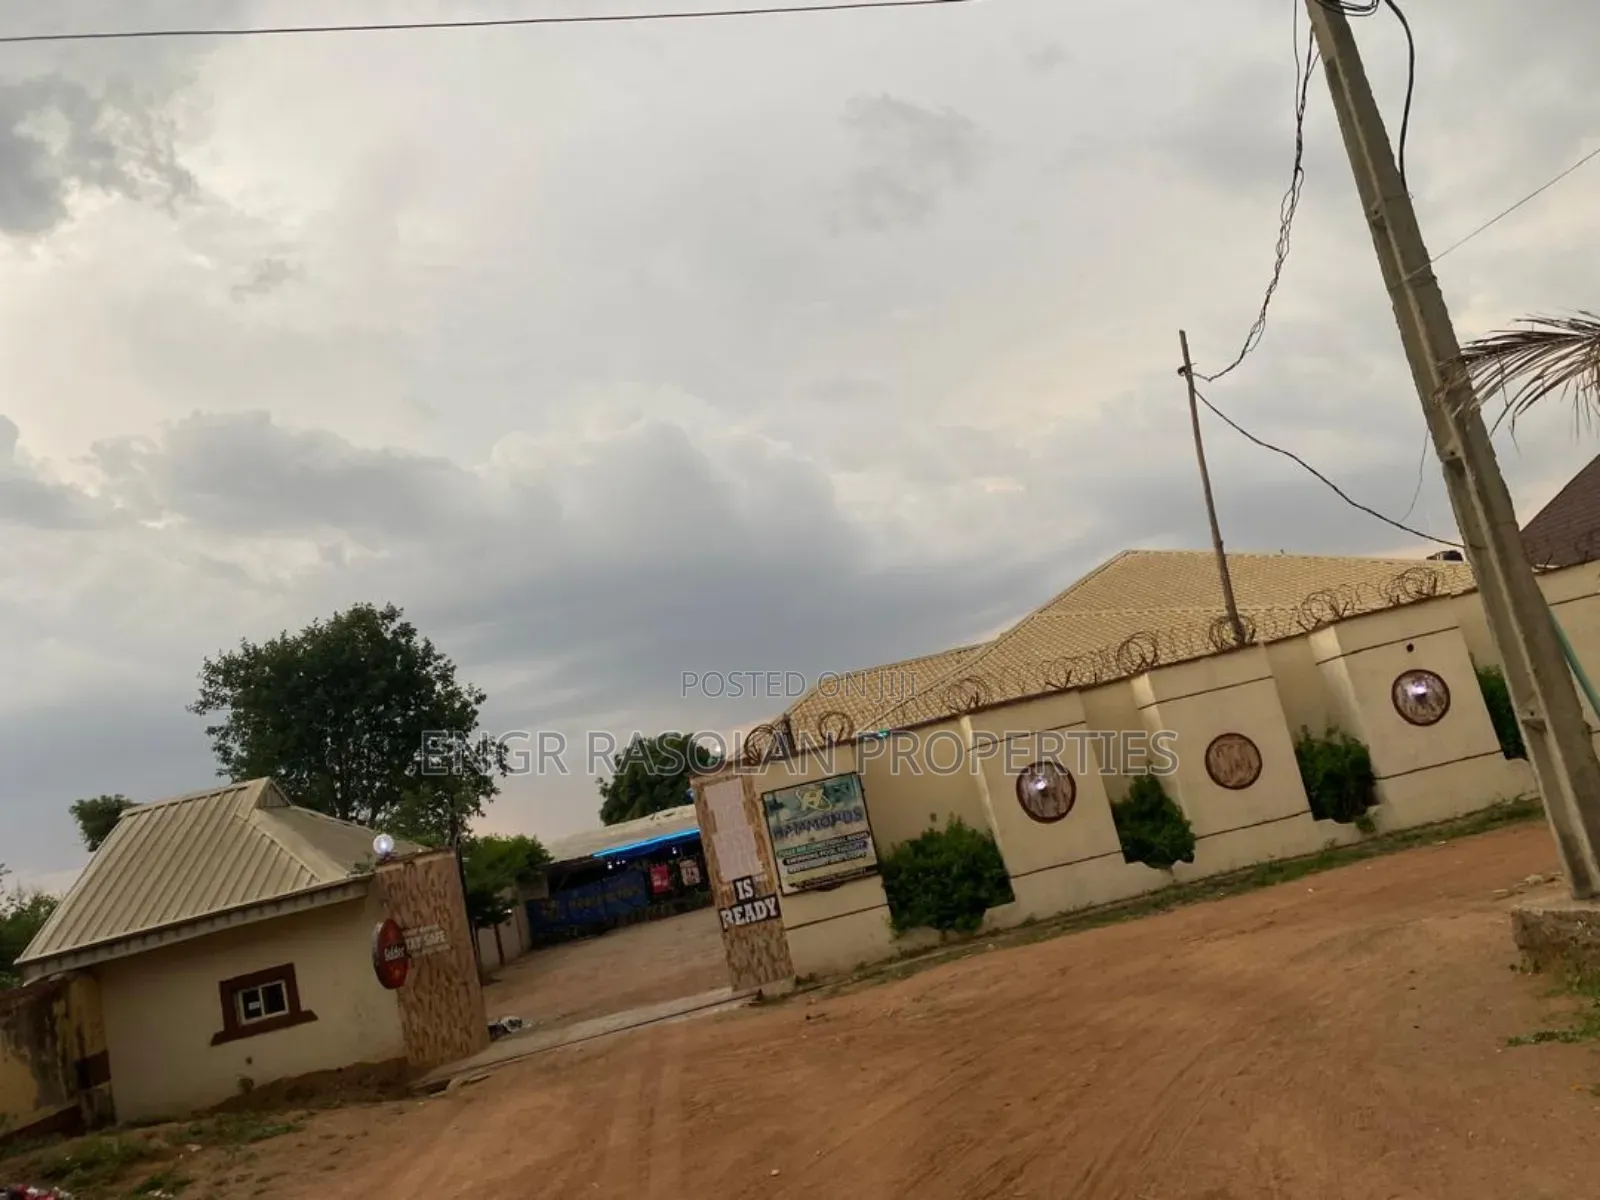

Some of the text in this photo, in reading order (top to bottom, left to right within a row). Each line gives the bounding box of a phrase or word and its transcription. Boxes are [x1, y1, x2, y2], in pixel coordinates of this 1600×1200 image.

[736, 879, 754, 900] IS
[720, 897, 778, 930] READY
[405, 935, 422, 950] TAY
